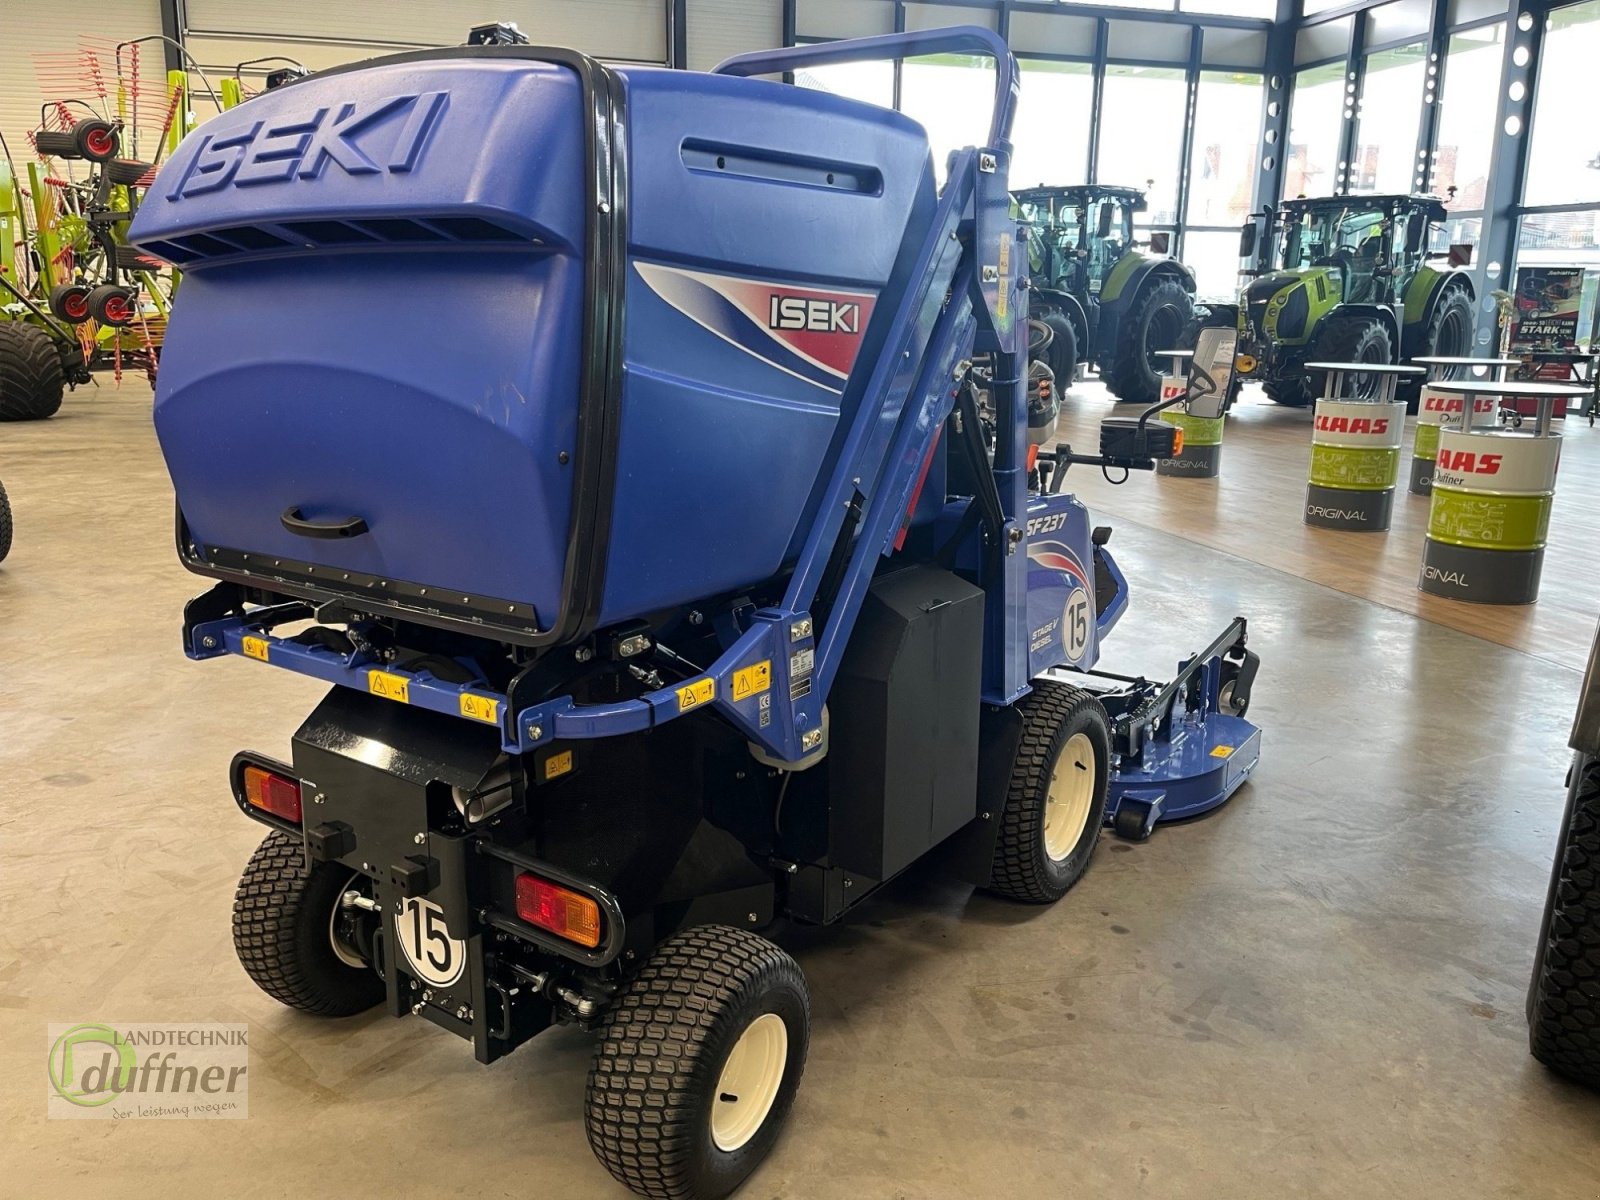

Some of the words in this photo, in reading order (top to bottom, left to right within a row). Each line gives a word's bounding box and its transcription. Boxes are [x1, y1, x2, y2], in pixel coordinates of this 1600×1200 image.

[166, 89, 450, 202] ISEKI
[770, 295, 860, 334] ISEKI
[1520, 326, 1560, 334] STARK
[1313, 415, 1389, 434] CLAAS
[1161, 459, 1208, 469] ORIGINAL
[1438, 449, 1503, 475] AAS
[1307, 505, 1368, 521] ORIGINAL
[1027, 513, 1068, 536] SF237
[1424, 565, 1469, 587] GINAL
[1032, 626, 1053, 640] STAGE
[1069, 602, 1087, 650] 15
[1030, 635, 1053, 652] DIESEL
[407, 899, 452, 973] 15
